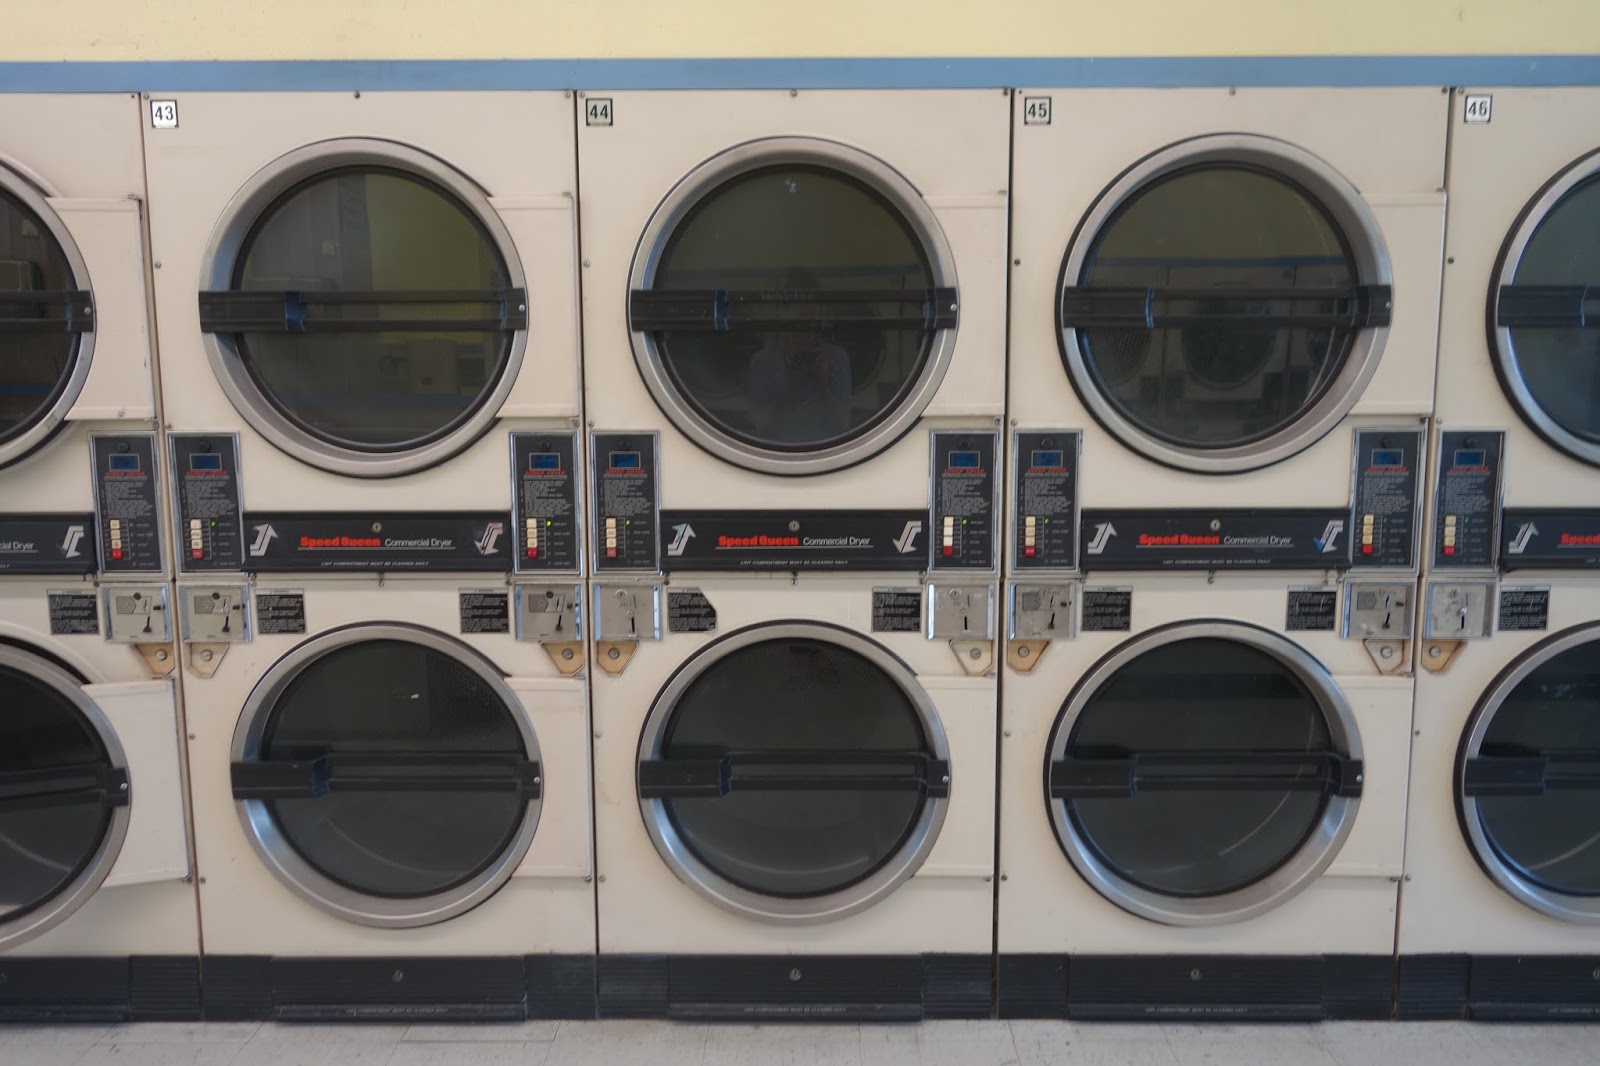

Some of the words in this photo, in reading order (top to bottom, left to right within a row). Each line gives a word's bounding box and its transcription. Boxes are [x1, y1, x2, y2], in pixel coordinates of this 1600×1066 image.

[155, 105, 174, 121] 43
[589, 104, 609, 119] 44
[1028, 102, 1048, 118] 45
[1468, 101, 1488, 116] 46
[12, 540, 34, 551] Dryer
[300, 536, 340, 549] Speed
[340, 536, 381, 547] Queen
[384, 538, 430, 547] Commercial
[430, 538, 453, 548] Dryer
[718, 535, 758, 548] Speed
[759, 535, 799, 546] Queen
[802, 536, 848, 546] Commercial
[850, 536, 871, 546] Dryer
[1139, 534, 1178, 546] Speed
[1179, 534, 1220, 544] Queen
[1224, 536, 1268, 544] Commercial
[1270, 536, 1292, 546] Dryer
